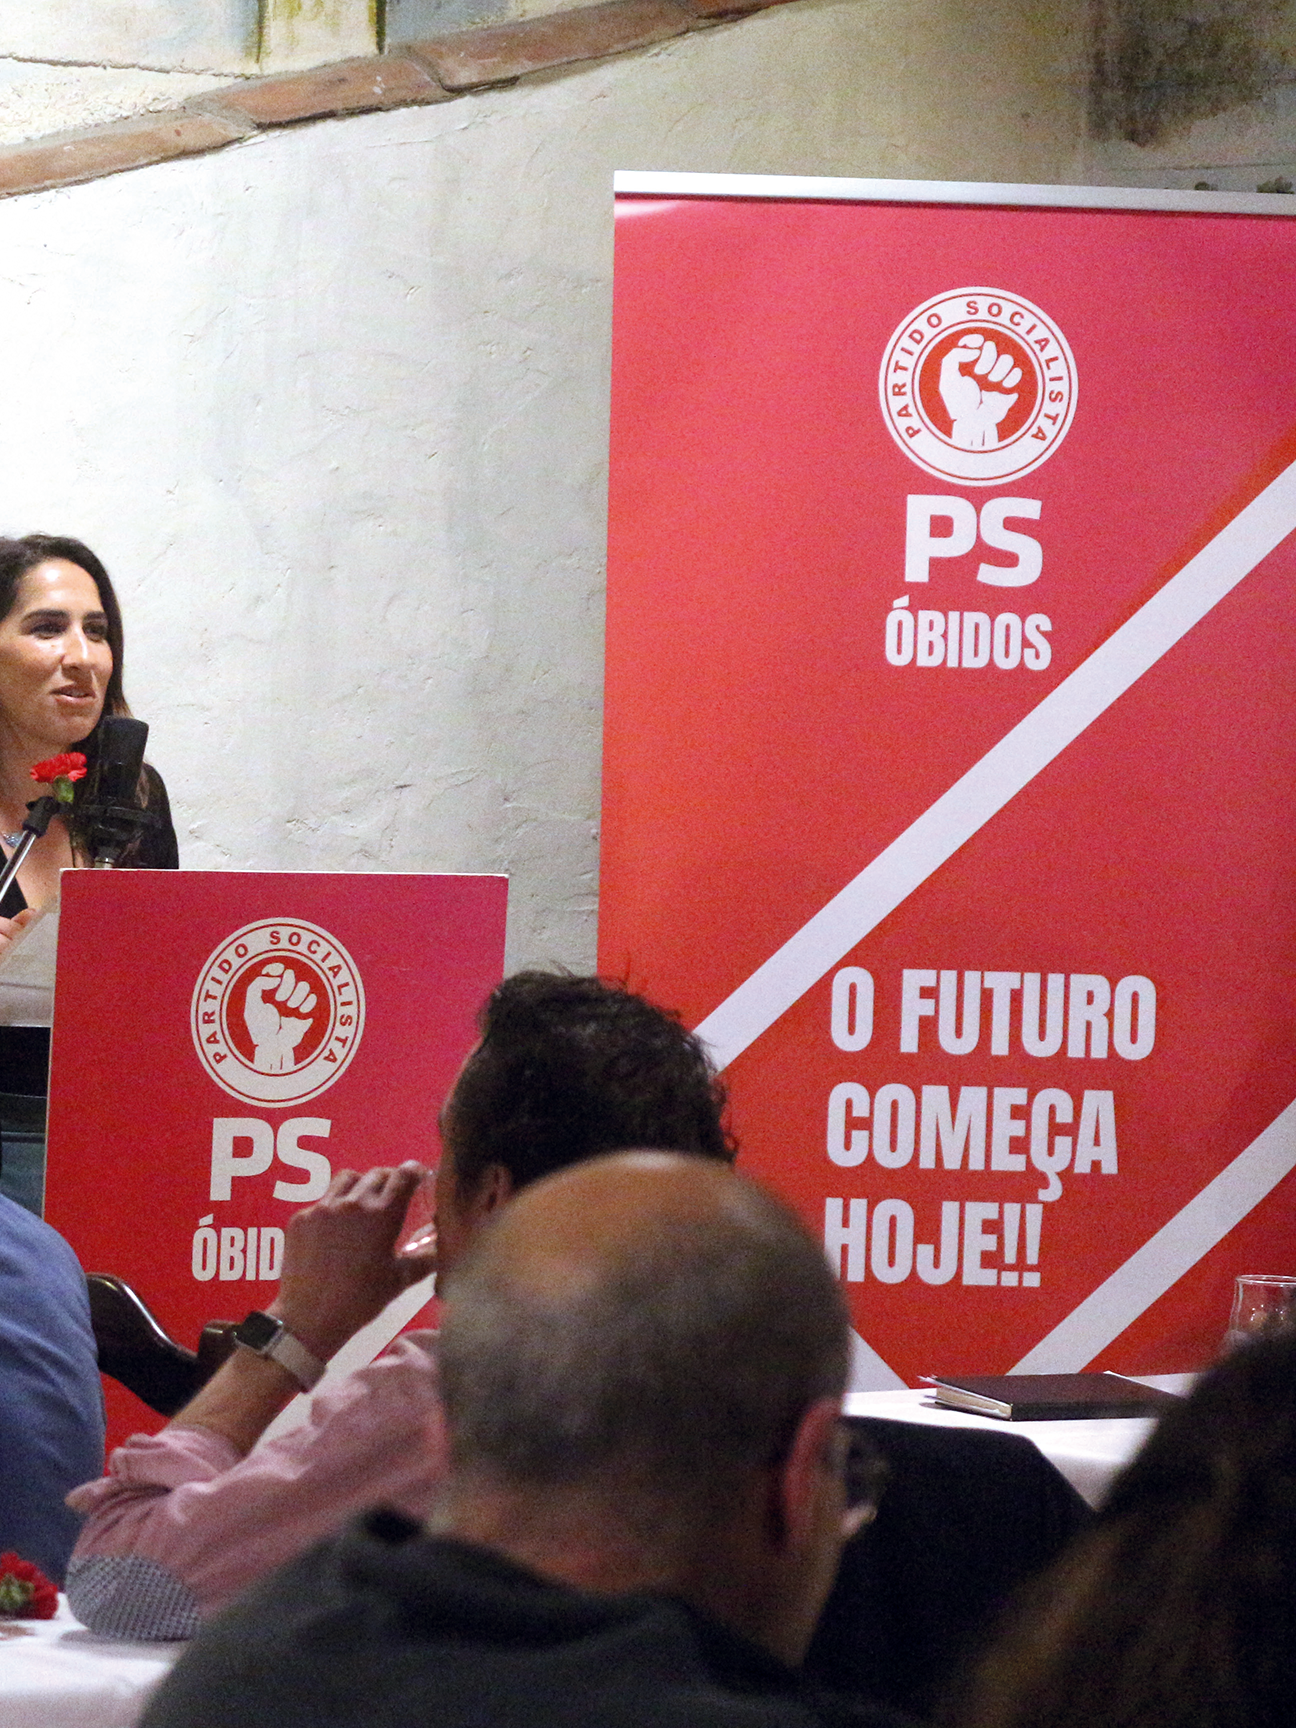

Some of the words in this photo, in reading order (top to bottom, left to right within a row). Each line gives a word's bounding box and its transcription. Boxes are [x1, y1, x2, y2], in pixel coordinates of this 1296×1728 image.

[892, 312, 942, 440] PARTIDO
[965, 299, 1064, 443] SOCIALISTA
[904, 493, 1044, 588] PS
[884, 594, 1053, 671] ÓBIDOS
[203, 943, 249, 1065] PARTIDO
[269, 930, 353, 1065] SOCIALISTA
[830, 966, 875, 1052] O
[900, 968, 1157, 1061] FUTURO
[209, 1117, 333, 1203] PS
[826, 1082, 1119, 1202] COMEÇA
[191, 1213, 285, 1281] ÓBID
[824, 1197, 1044, 1288] HOJE!!
